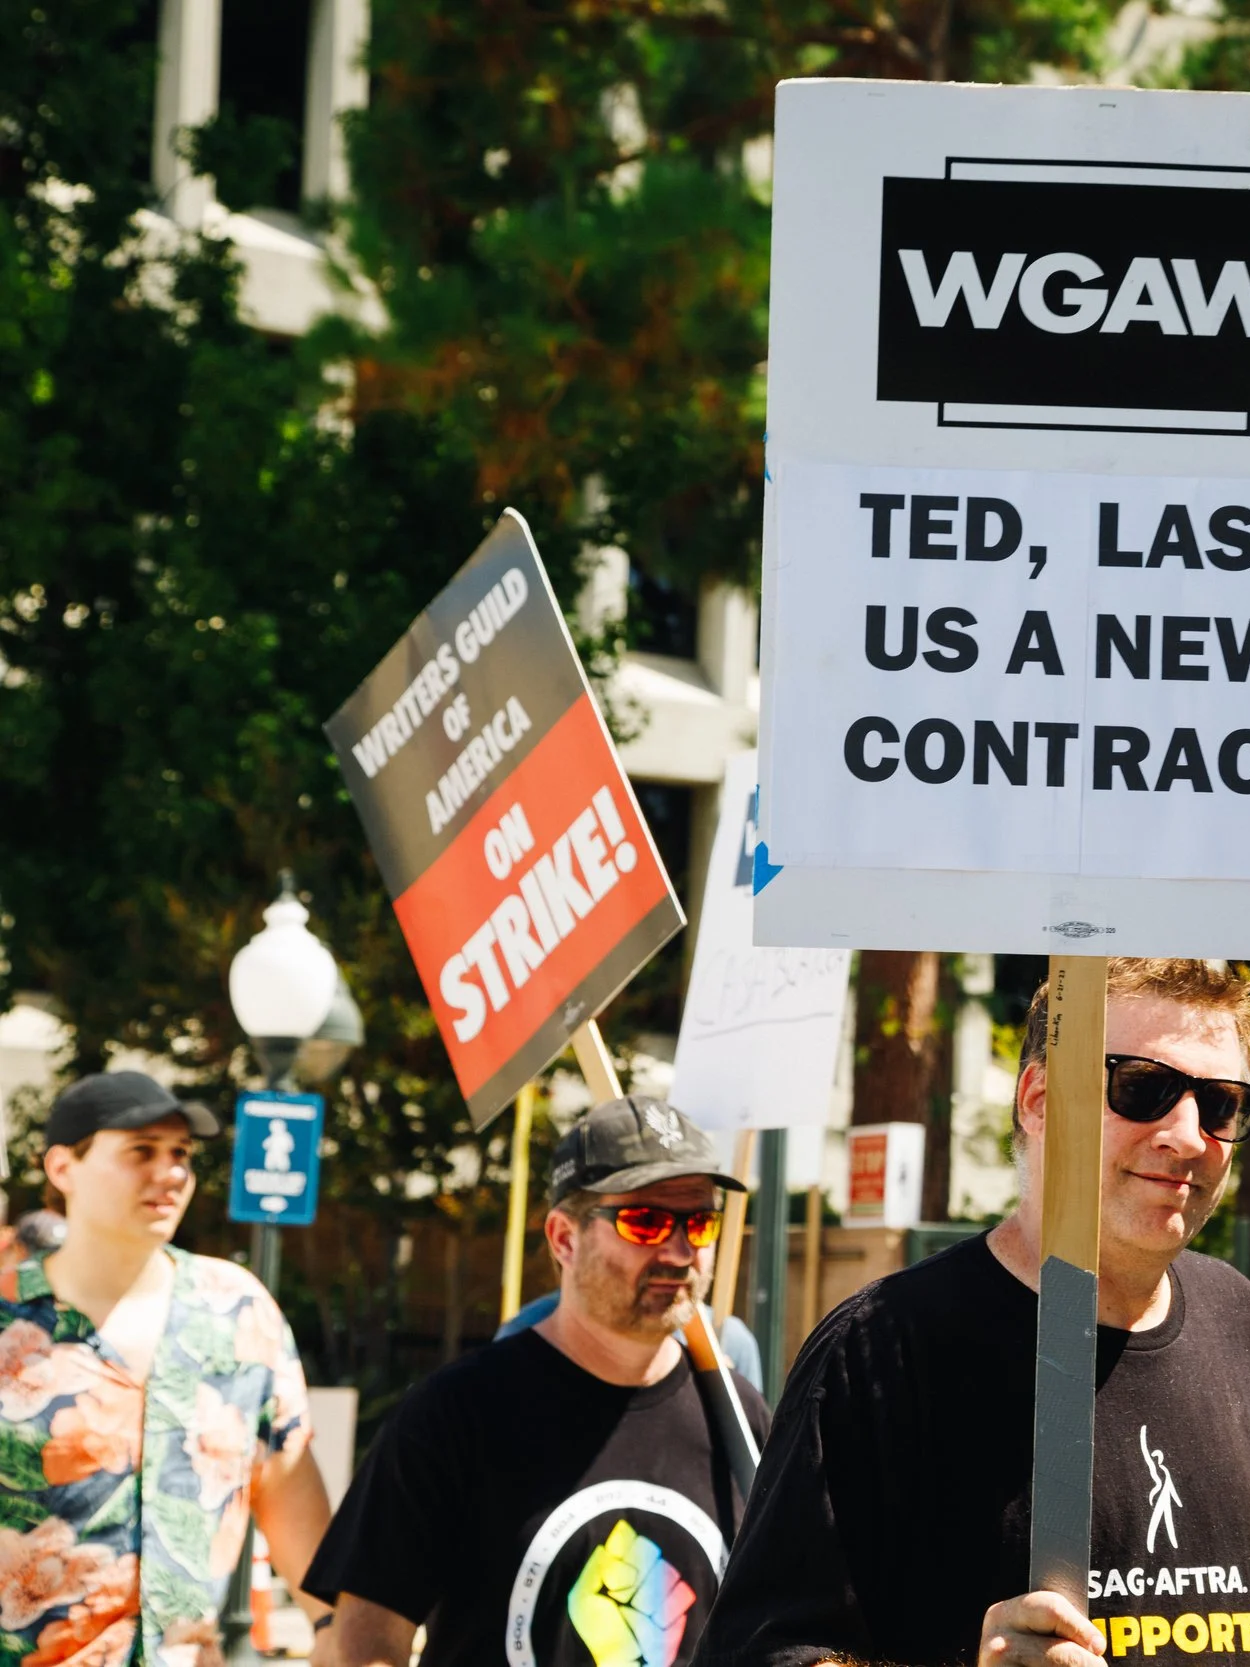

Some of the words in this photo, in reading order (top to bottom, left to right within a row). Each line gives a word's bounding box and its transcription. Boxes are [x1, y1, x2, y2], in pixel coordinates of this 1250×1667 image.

[860, 493, 1048, 579] TED,
[351, 650, 460, 779] WRITERS
[454, 568, 529, 665] GUILD
[865, 605, 979, 673] US
[1005, 610, 1065, 676] A
[442, 694, 471, 742] OF
[424, 696, 532, 835] AMERICA
[483, 802, 535, 880] ON
[439, 785, 638, 1044] STRIKE!
